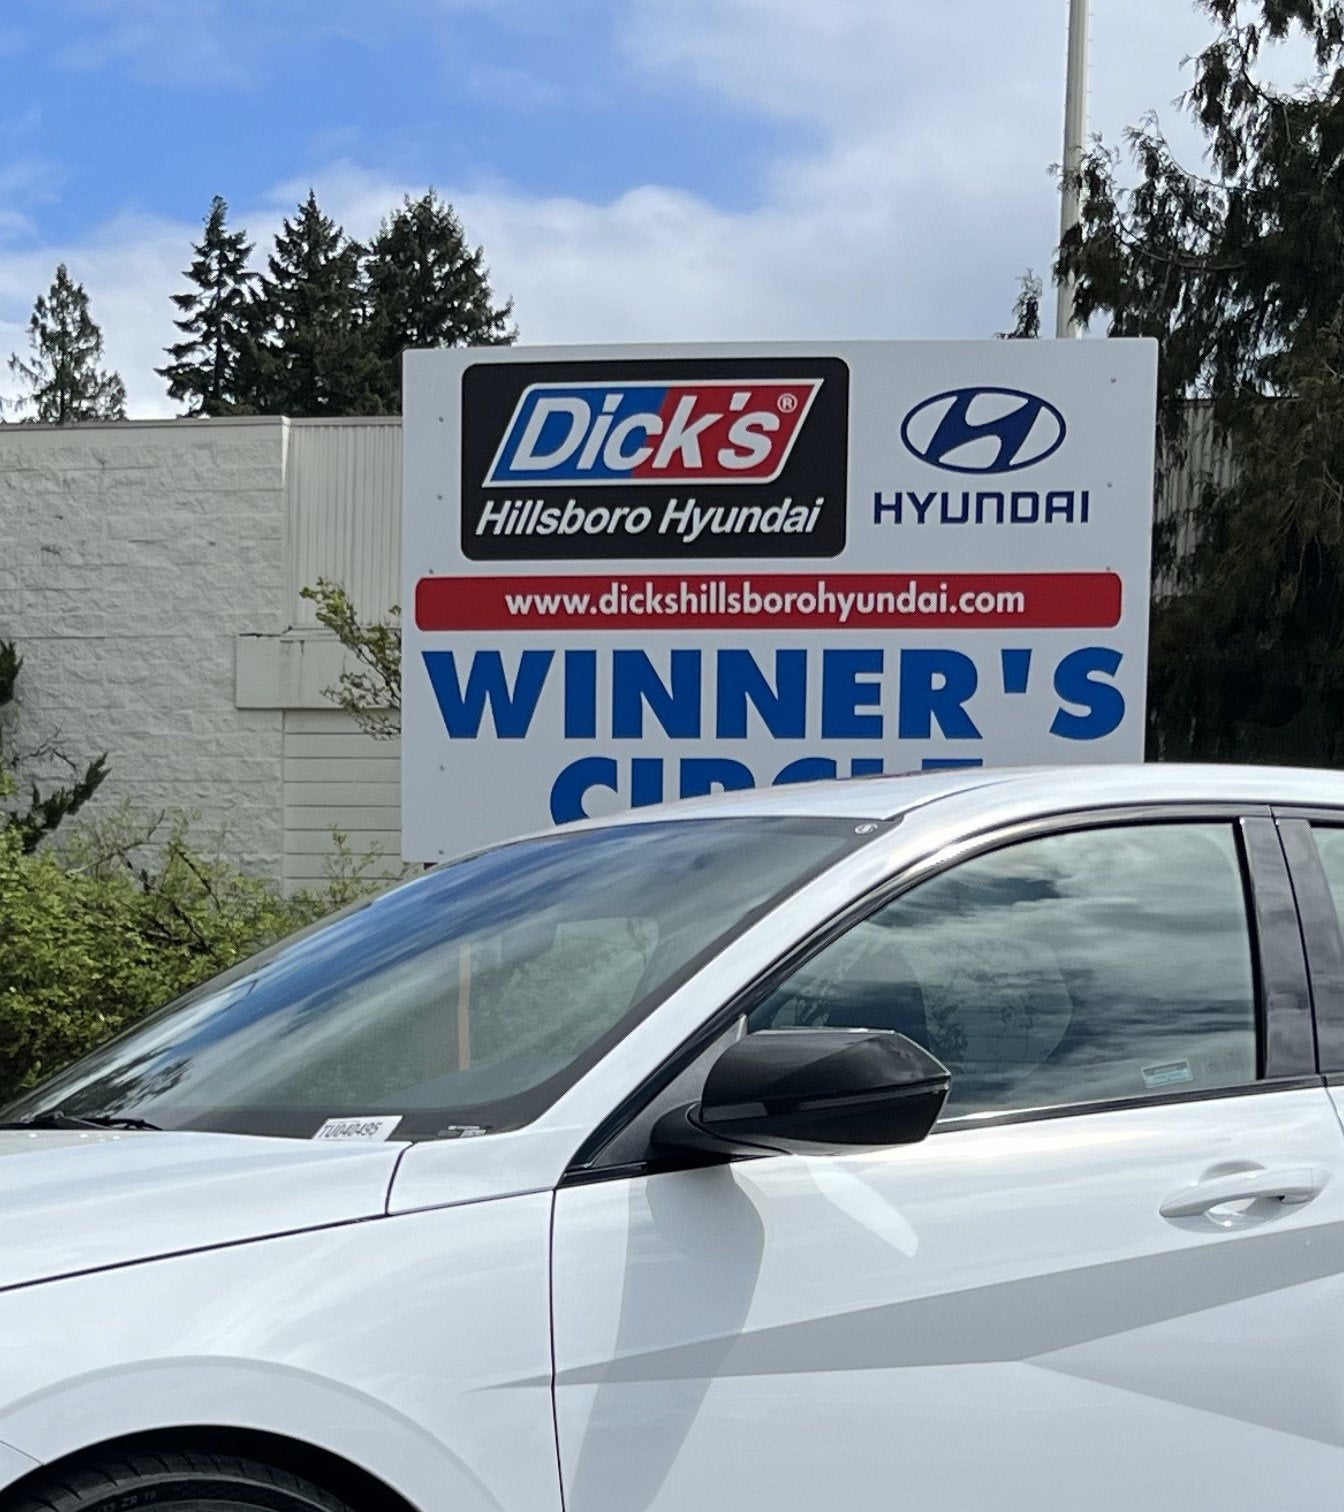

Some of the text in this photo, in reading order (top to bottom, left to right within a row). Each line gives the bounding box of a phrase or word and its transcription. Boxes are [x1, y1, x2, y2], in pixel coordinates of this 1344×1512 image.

[476, 497, 824, 543] Hillsboro Hyundai
[873, 490, 1090, 525] HYUNDAI
[505, 582, 1025, 622] www.dickshillsborohyundai.com
[422, 645, 1126, 740] WINNER'S
